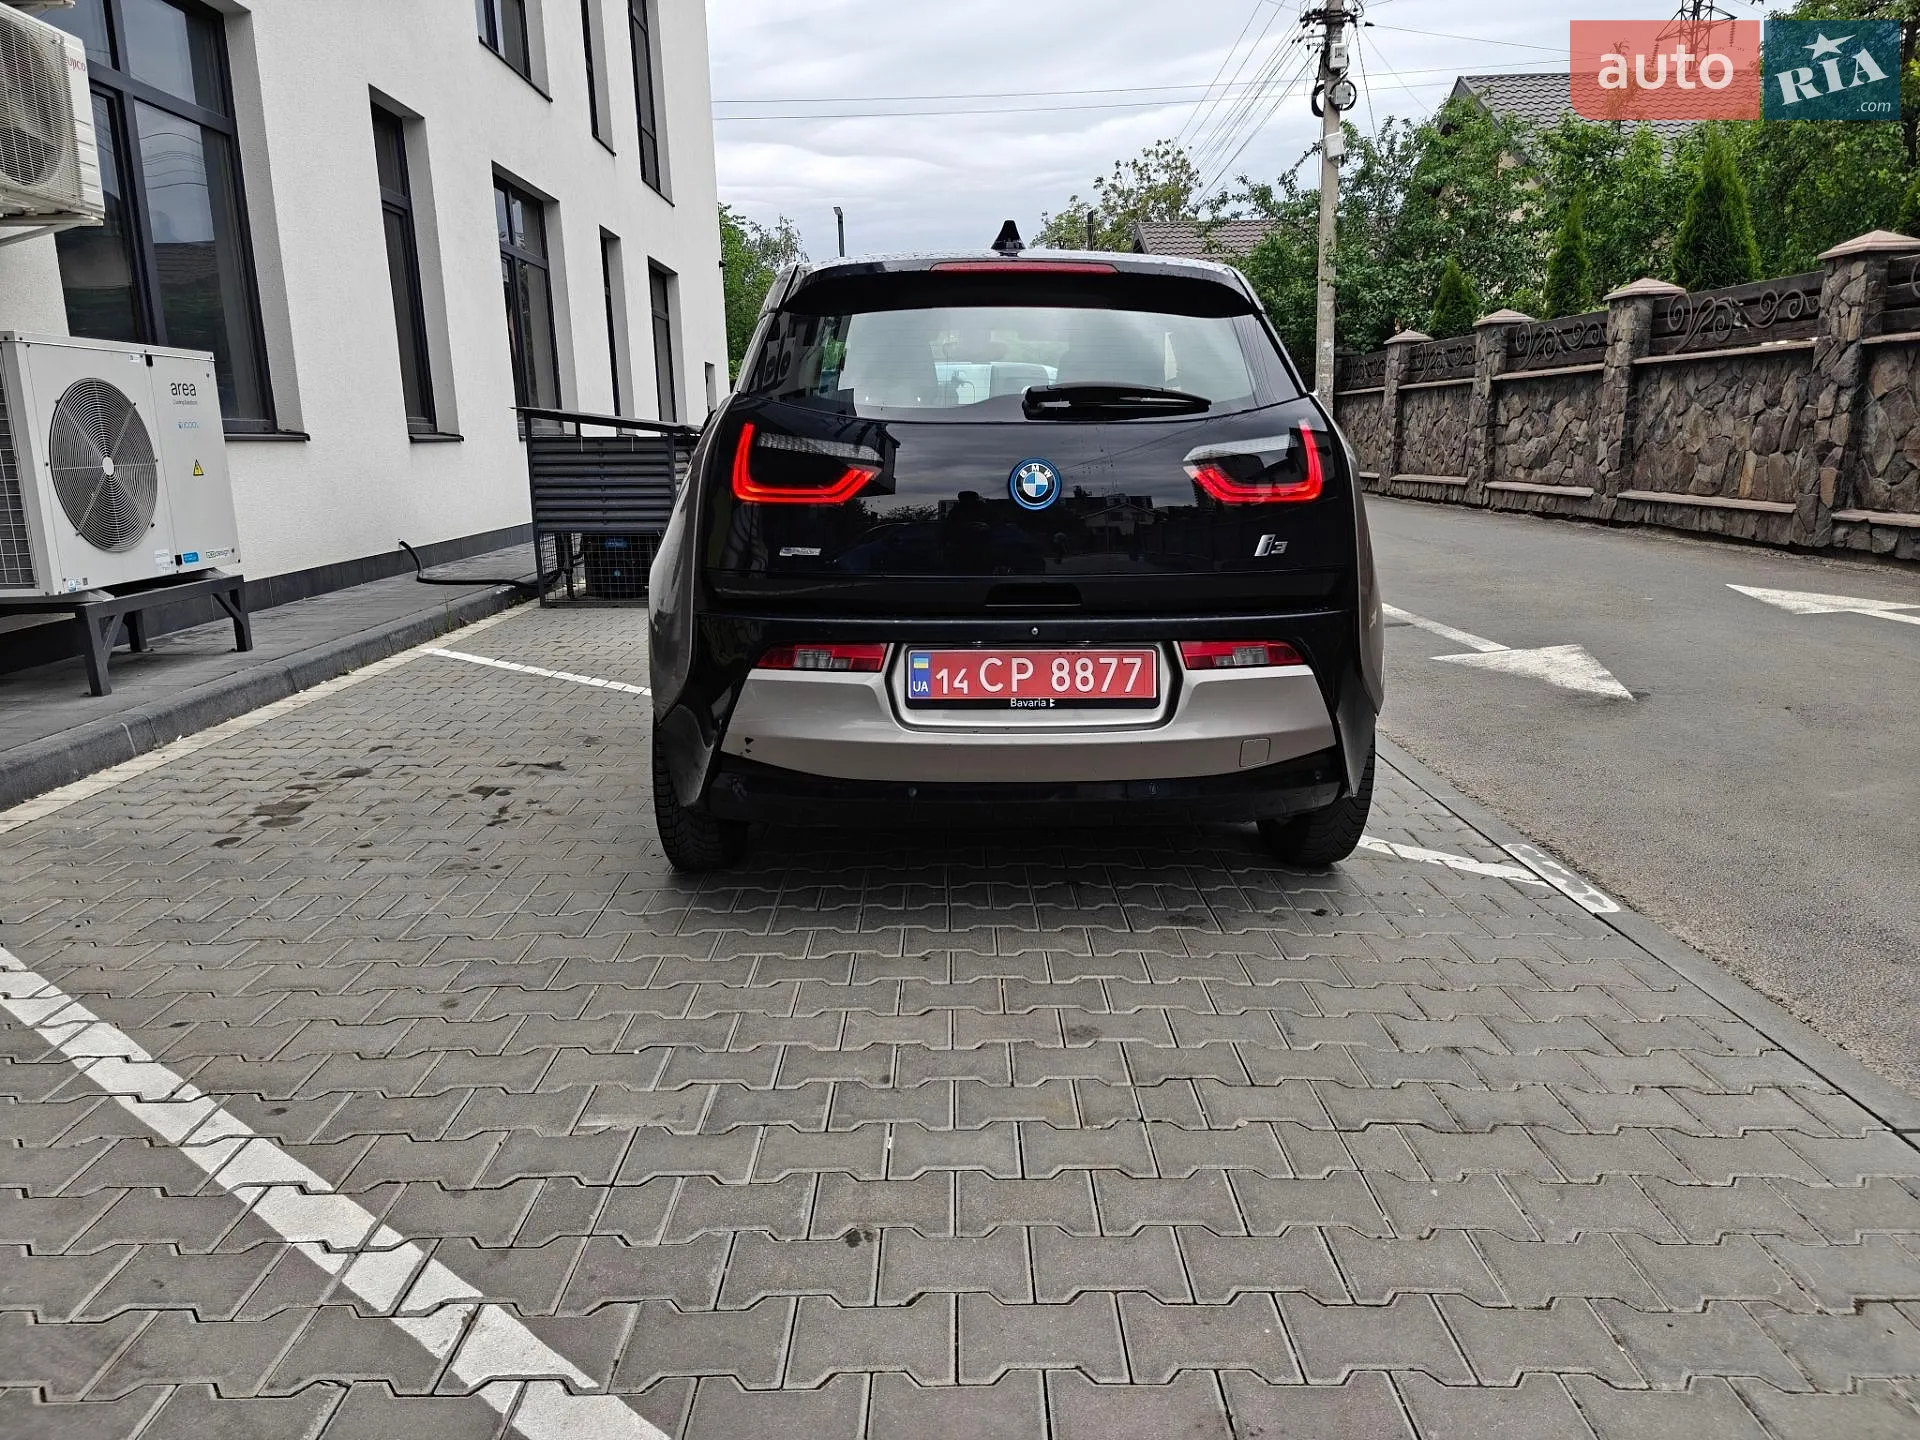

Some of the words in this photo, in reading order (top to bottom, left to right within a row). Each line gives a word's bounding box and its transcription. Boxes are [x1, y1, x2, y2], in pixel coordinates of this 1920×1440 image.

[170, 382, 197, 397] area
[913, 681, 929, 693] UA
[935, 668, 969, 695] 14
[978, 657, 1034, 693] CP
[1051, 657, 1143, 693] 8877
[1010, 697, 1047, 708] Bavaria
